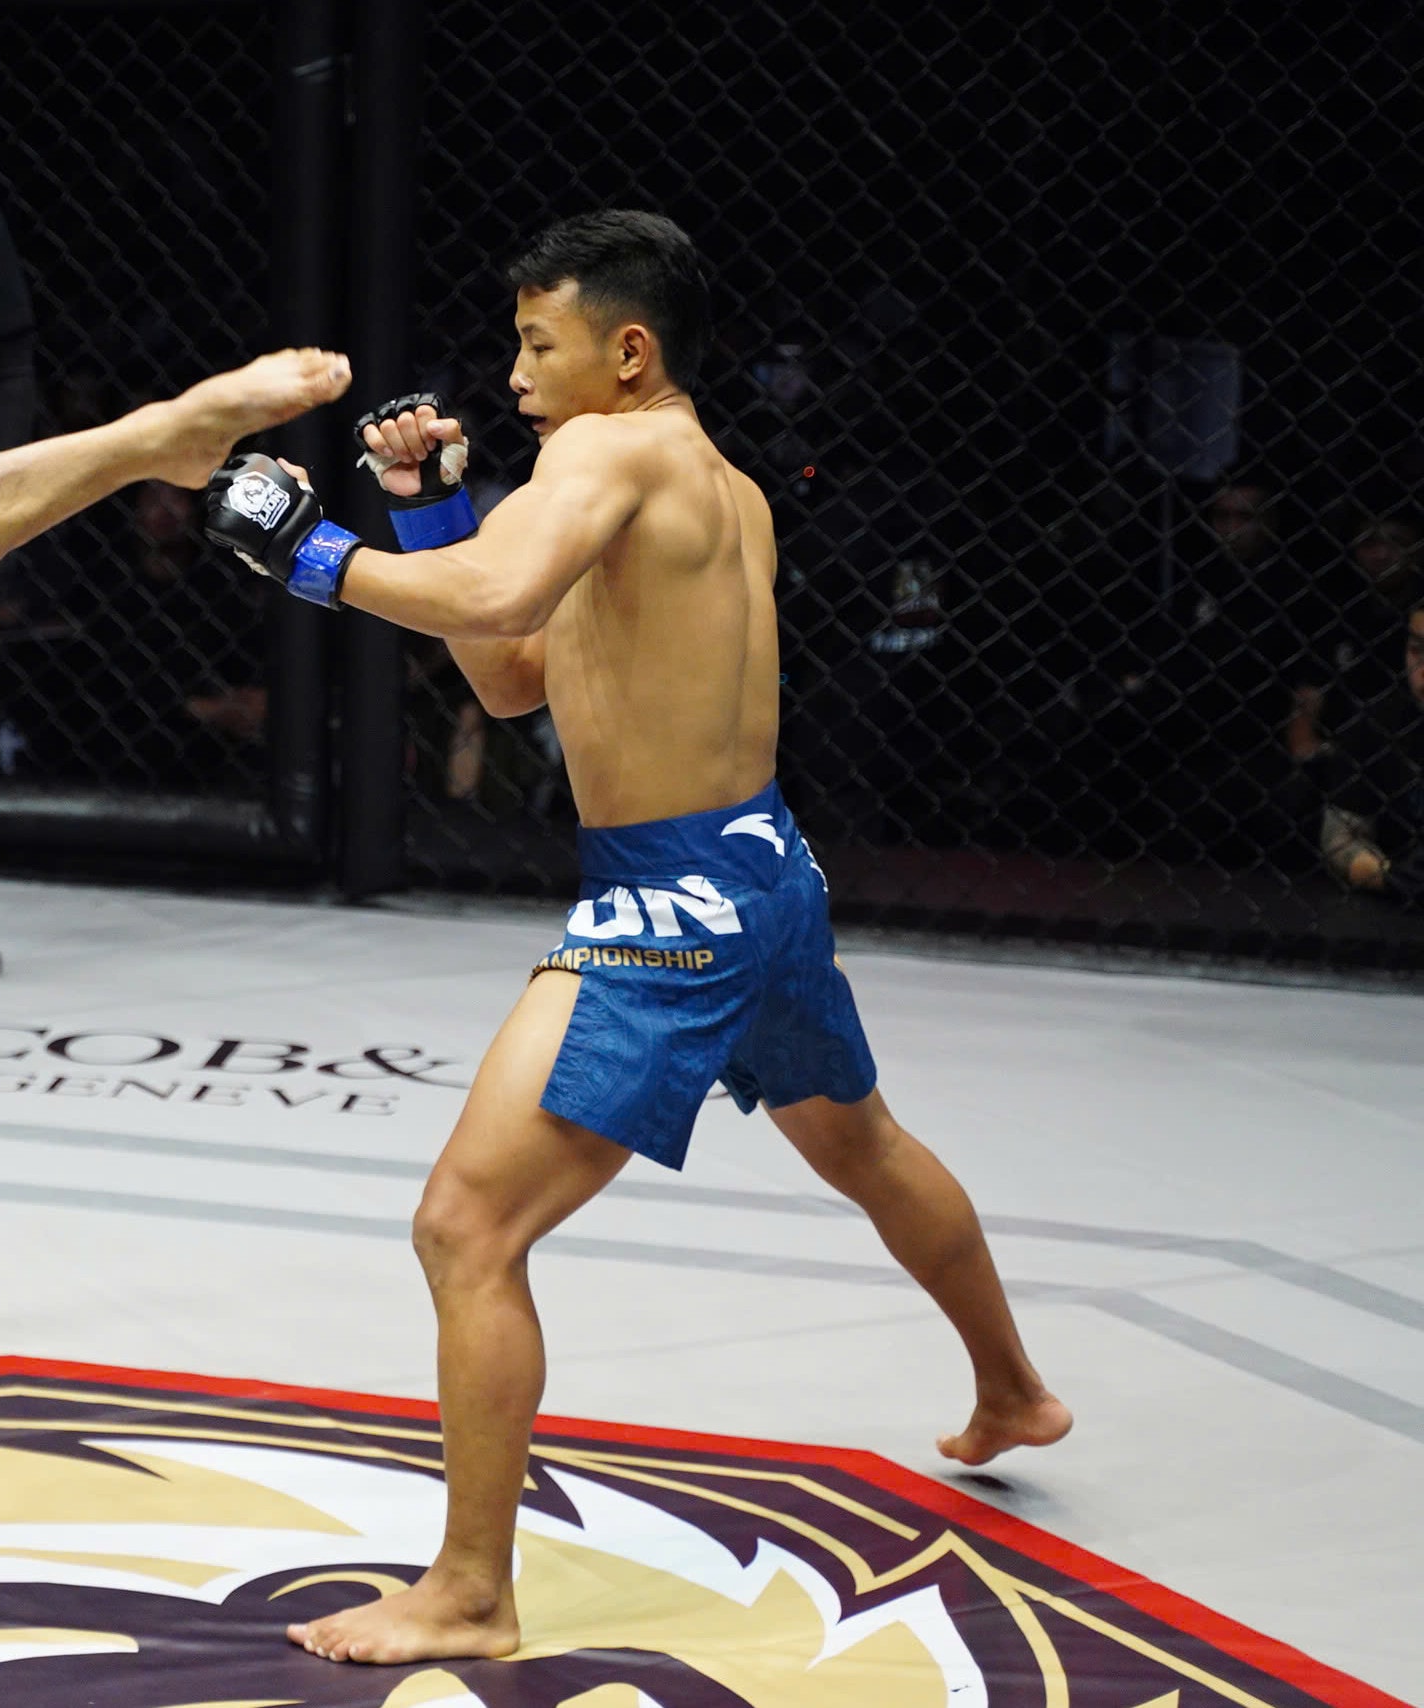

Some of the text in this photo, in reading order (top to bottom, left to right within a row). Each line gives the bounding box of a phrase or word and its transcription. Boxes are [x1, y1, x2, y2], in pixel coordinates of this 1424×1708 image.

[257, 489, 286, 524] LION
[567, 874, 744, 940] ON
[534, 946, 715, 974] AMPIONSHIP
